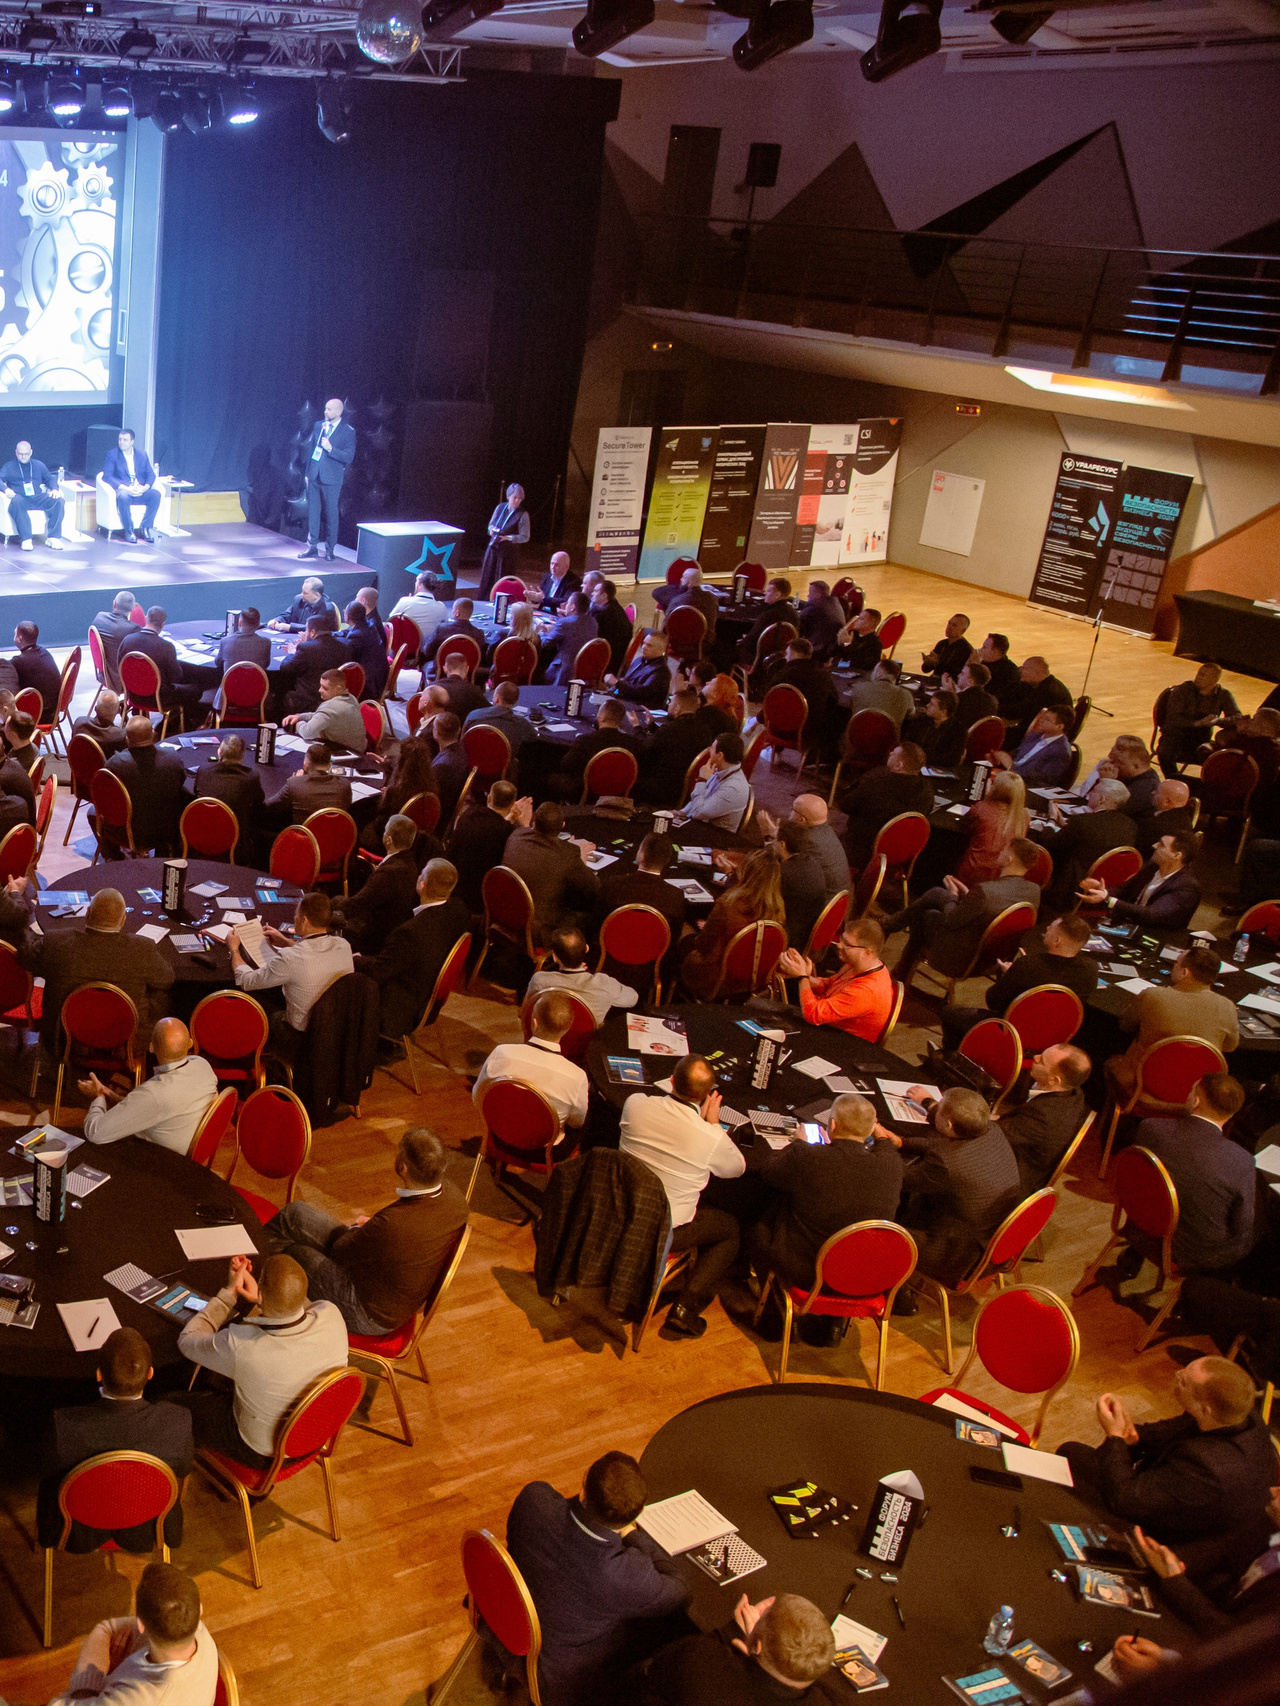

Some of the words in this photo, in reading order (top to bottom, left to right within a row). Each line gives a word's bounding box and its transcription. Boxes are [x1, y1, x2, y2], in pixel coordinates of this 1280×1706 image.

[602, 441, 646, 450] SecureTower
[1124, 500, 1178, 515] БЕЗОПАСНОСТЬ
[1154, 498, 1179, 508] ФОРУМ
[878, 1491, 893, 1522] ФОРУМ
[878, 1497, 902, 1557] БЕЗОПАСНОСТЬ
[887, 1525, 905, 1562] БИЗНЕСА
[899, 1500, 912, 1522] 2024
